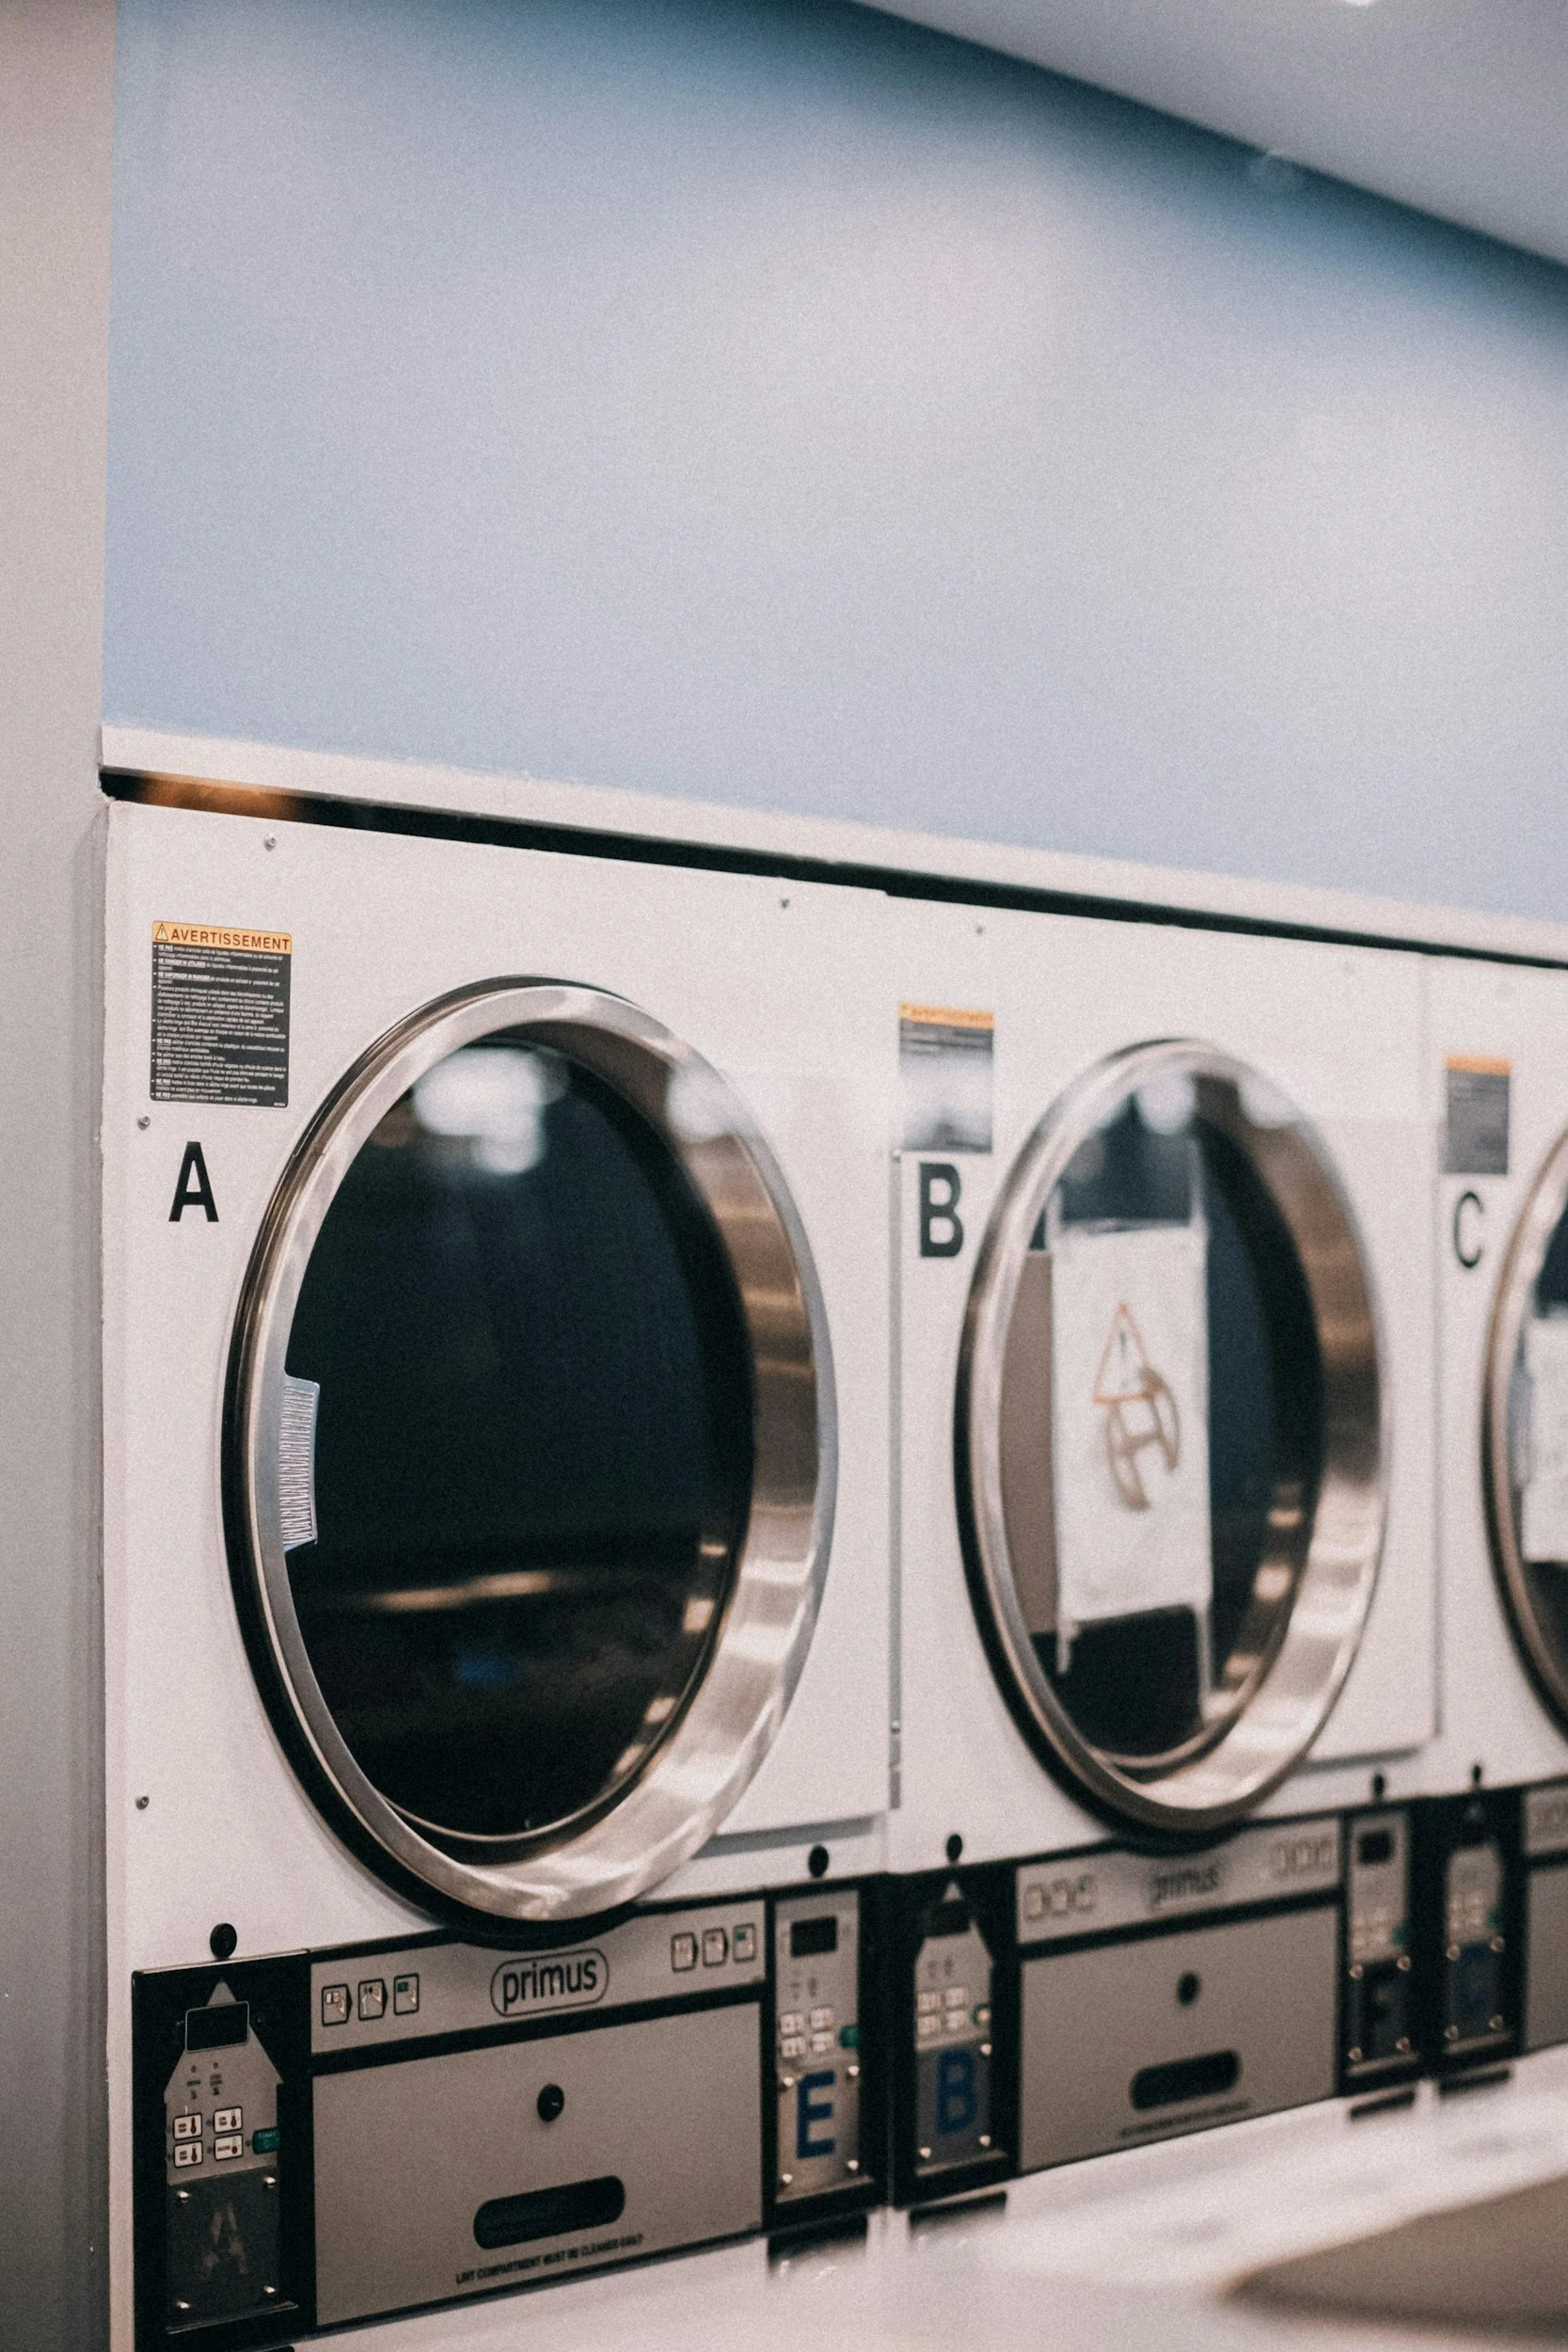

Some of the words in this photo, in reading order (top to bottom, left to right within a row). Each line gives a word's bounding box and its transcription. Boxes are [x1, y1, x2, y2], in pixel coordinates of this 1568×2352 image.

[171, 929, 290, 950] AVERTISSEMENT
[168, 1140, 219, 1222] A
[919, 1161, 964, 1258] B
[1453, 1191, 1484, 1268] C
[501, 1959, 597, 2011] primus
[796, 2070, 836, 2158] E
[938, 2047, 977, 2133] B
